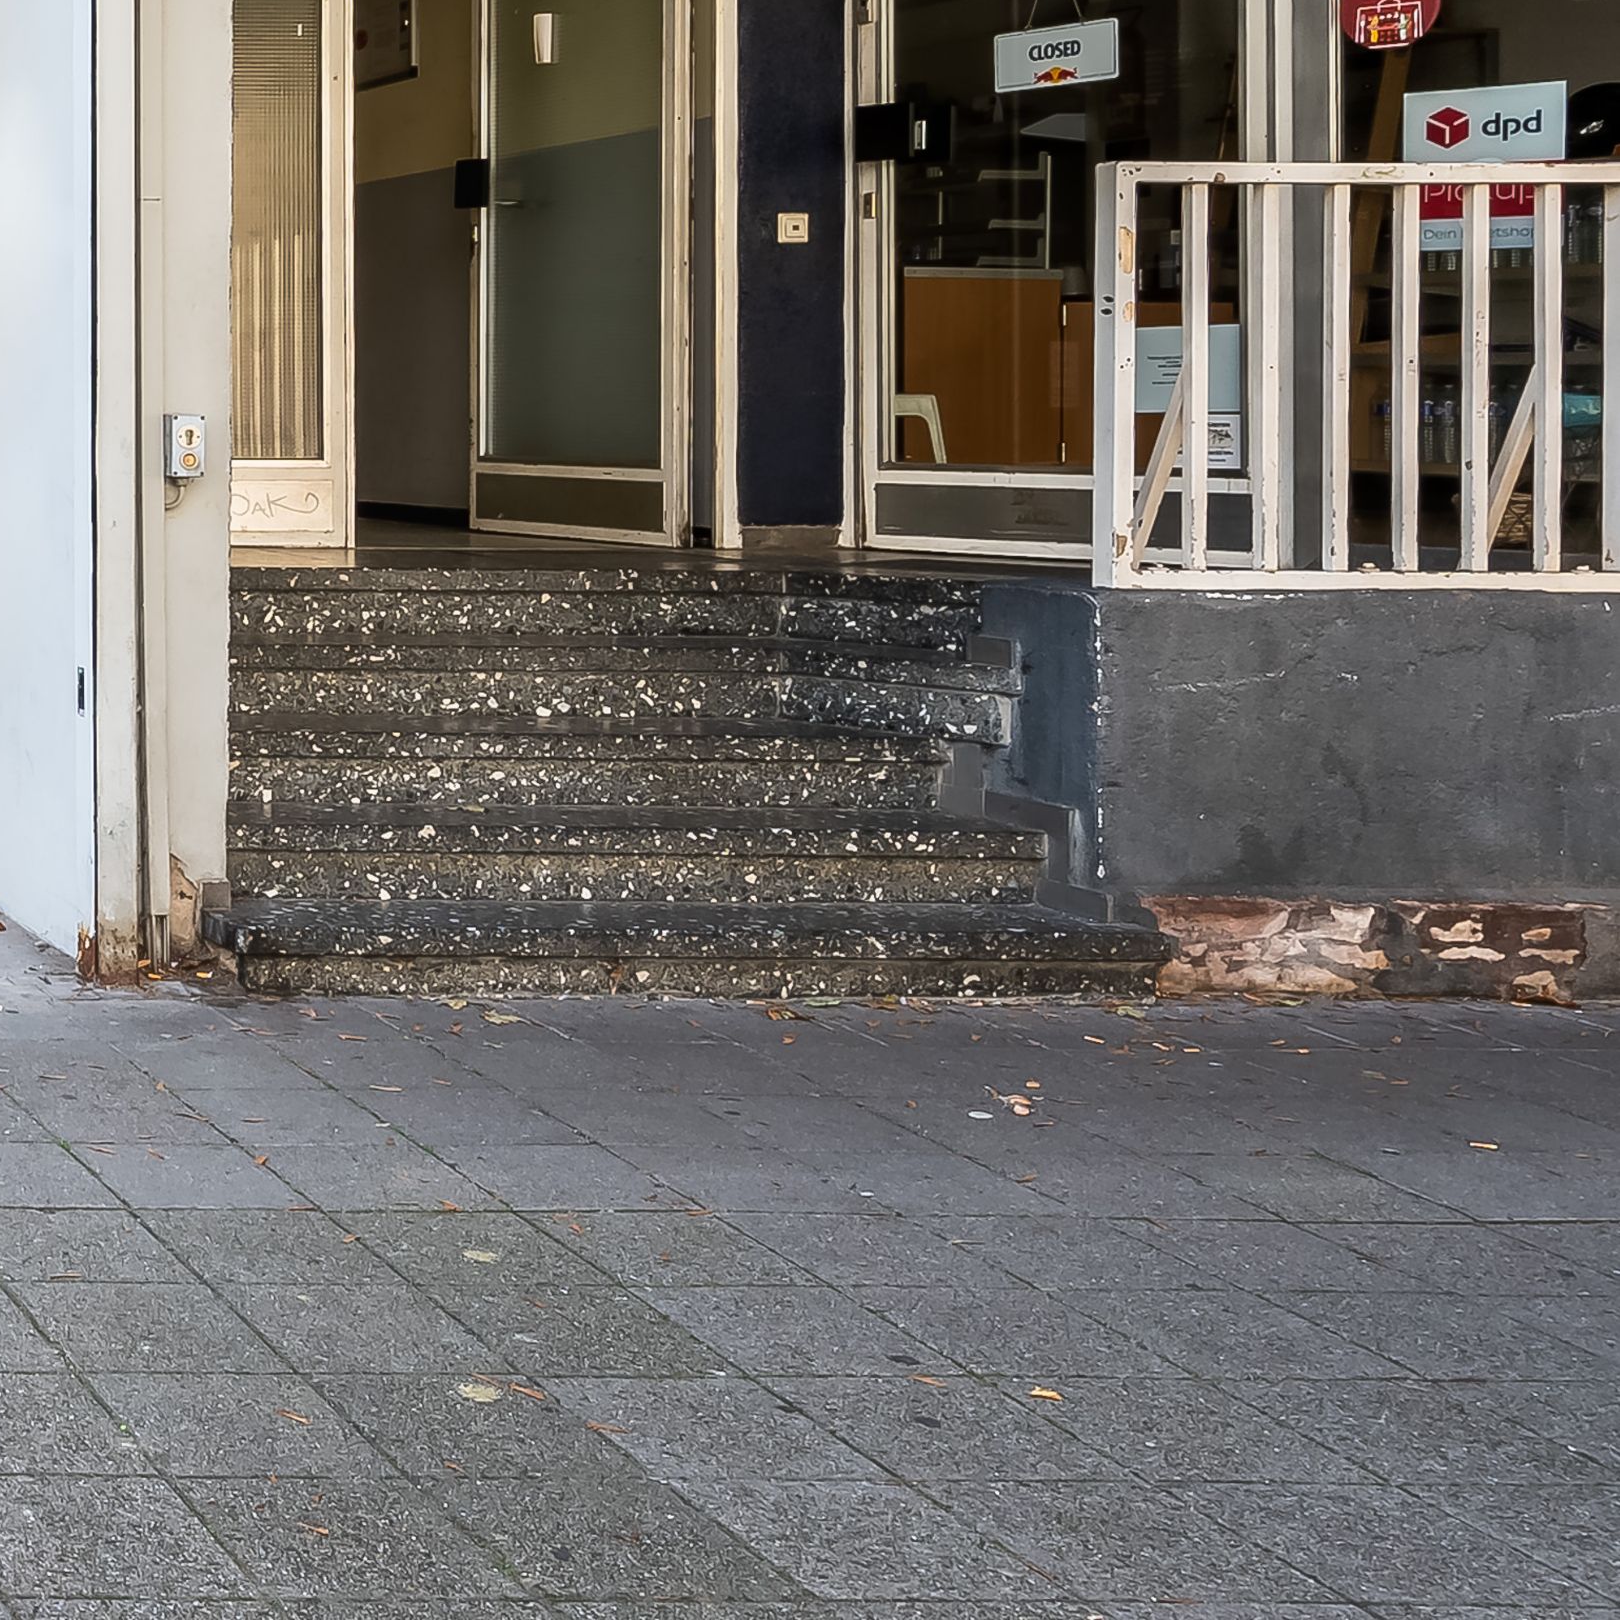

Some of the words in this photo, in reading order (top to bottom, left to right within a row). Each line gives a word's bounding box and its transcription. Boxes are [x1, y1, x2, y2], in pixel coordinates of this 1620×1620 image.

[1028, 40, 1081, 61] CLOSED
[1481, 109, 1543, 141] dpd
[1423, 229, 1457, 240] Dein
